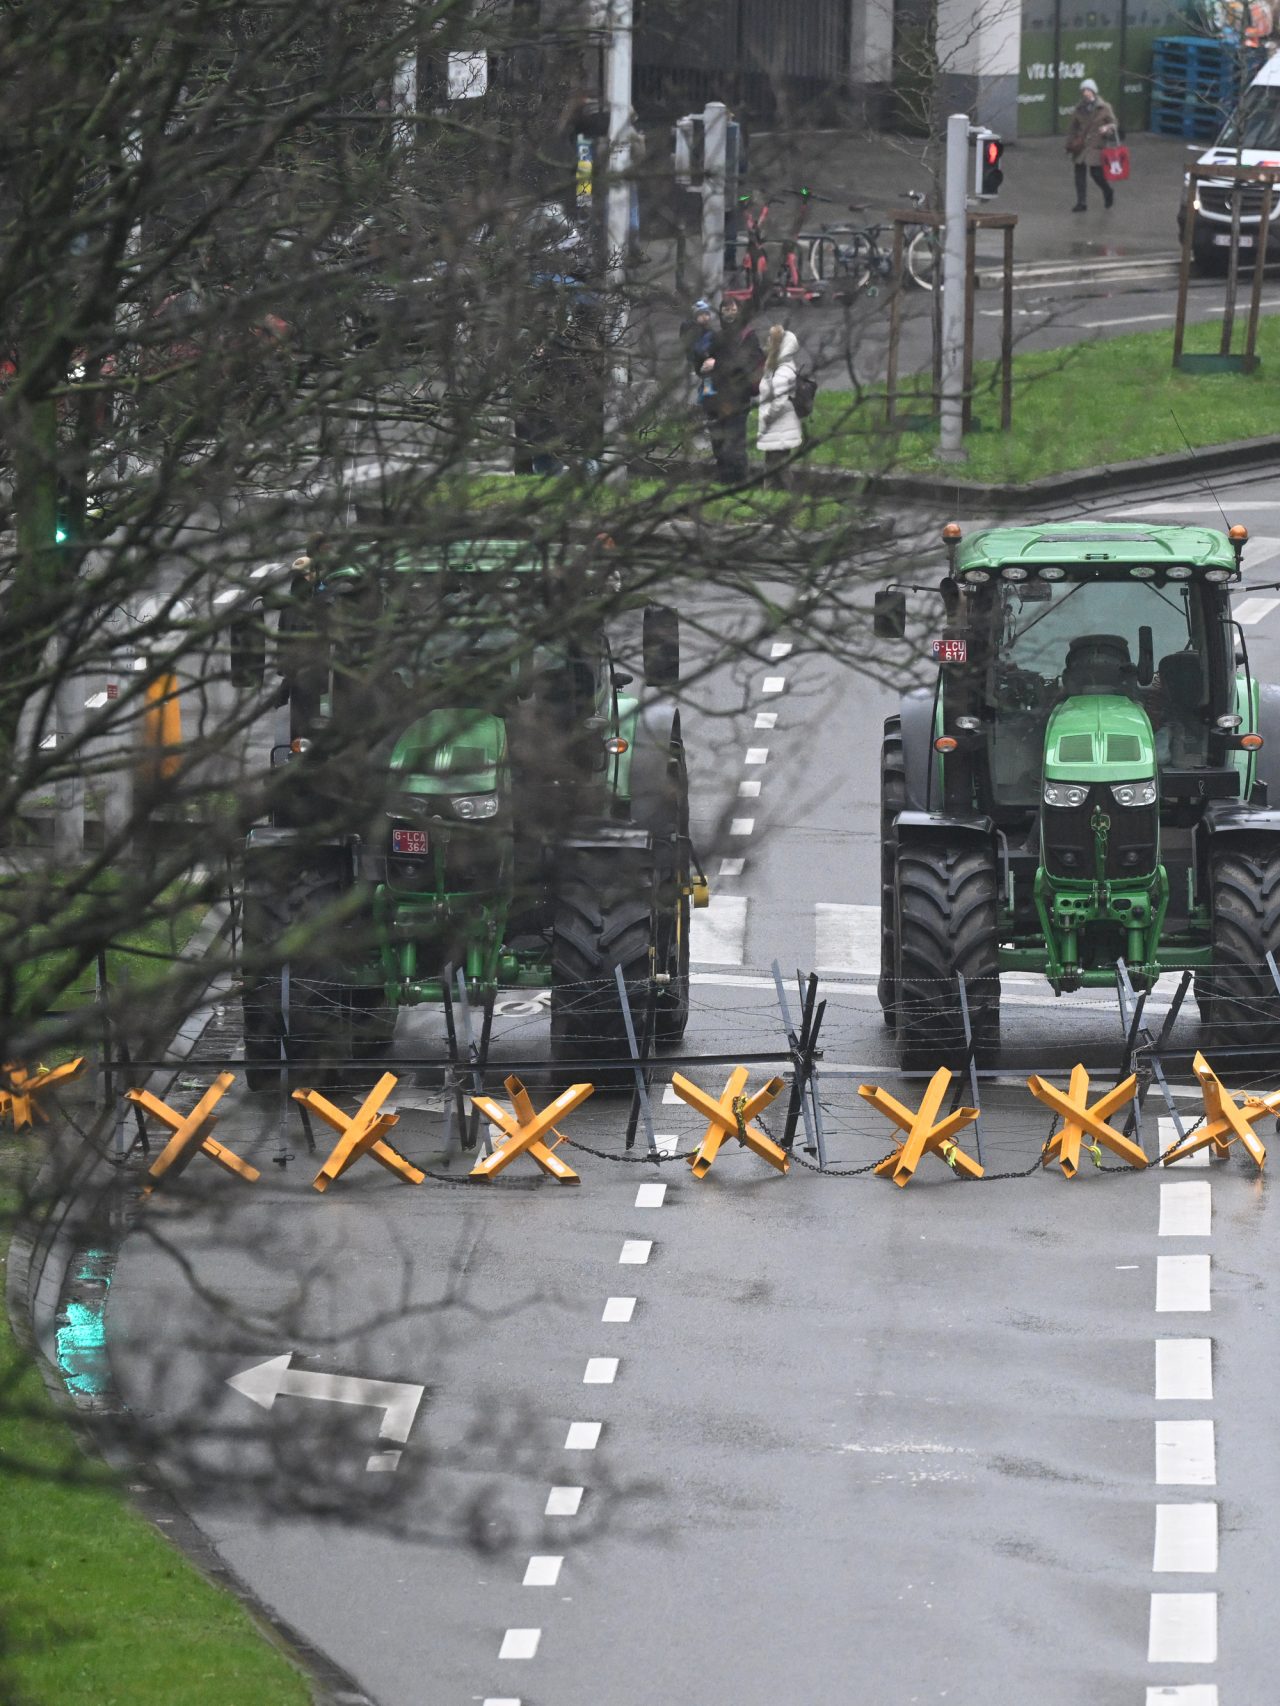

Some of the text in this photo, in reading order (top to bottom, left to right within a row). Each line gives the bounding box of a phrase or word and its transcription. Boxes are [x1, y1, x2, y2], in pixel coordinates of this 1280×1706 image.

[933, 641, 965, 652] G-LCU
[945, 651, 965, 661] 617
[395, 831, 426, 842] G-LCA
[407, 842, 426, 852] 364
